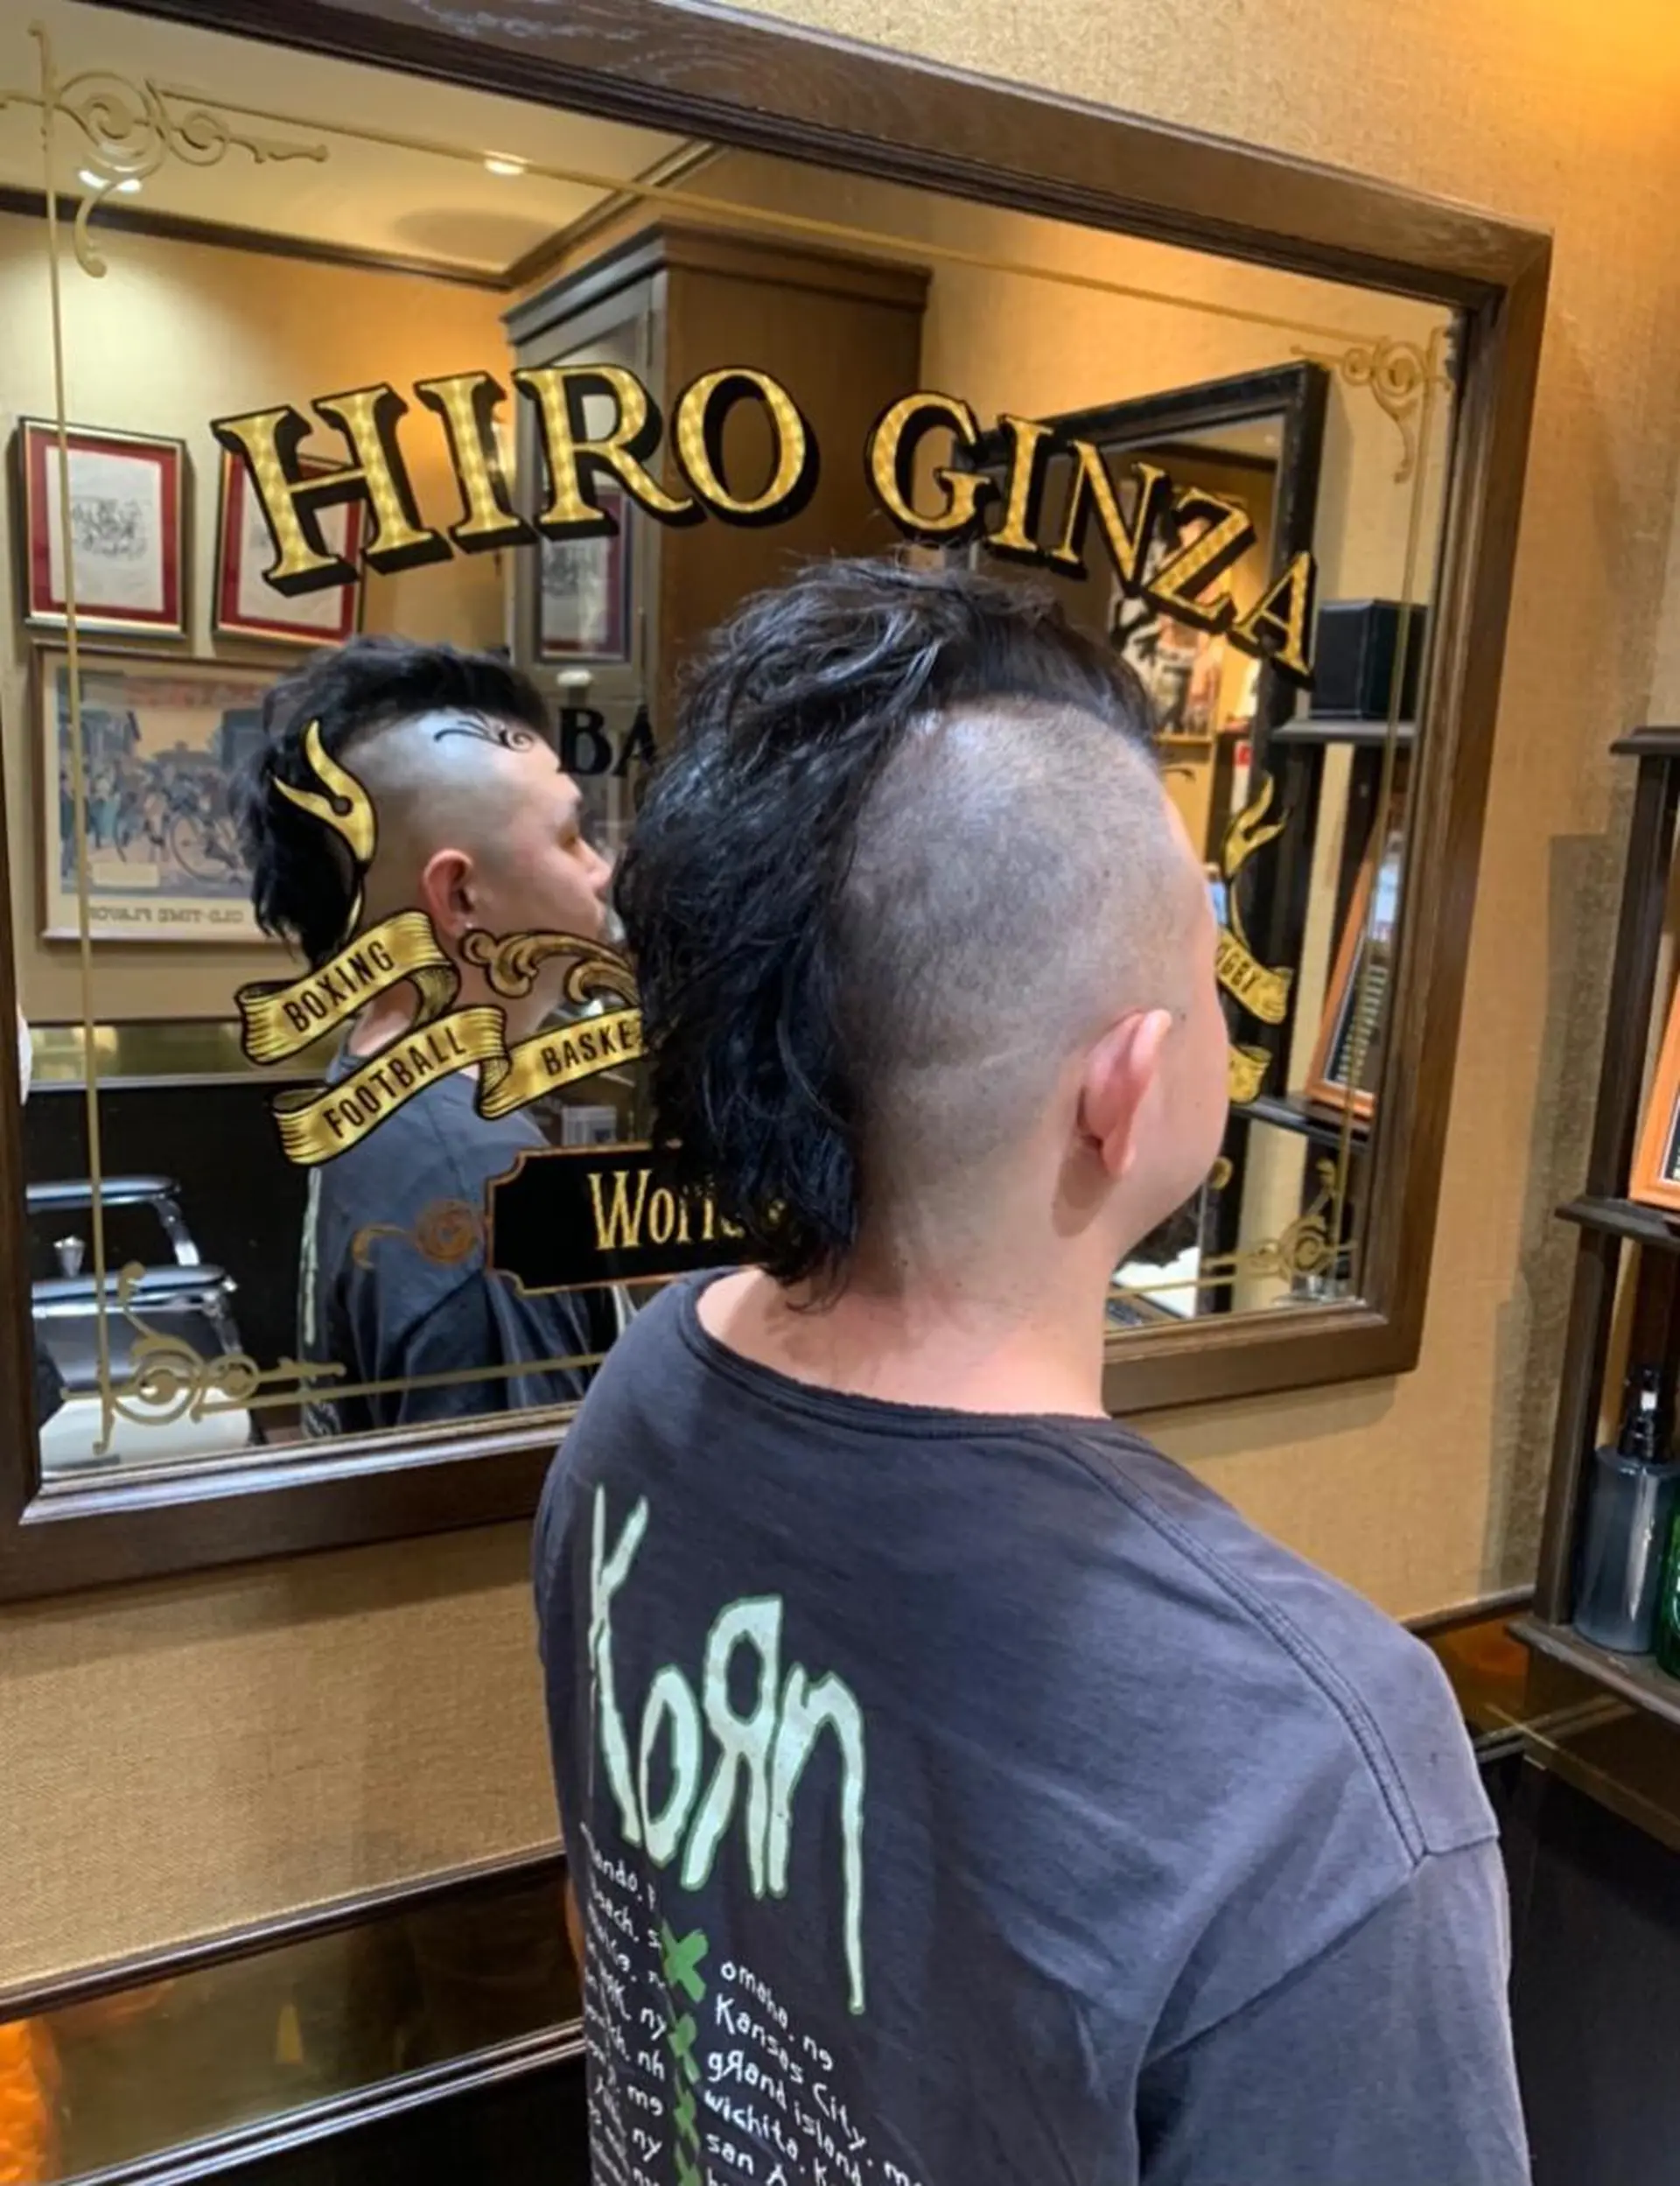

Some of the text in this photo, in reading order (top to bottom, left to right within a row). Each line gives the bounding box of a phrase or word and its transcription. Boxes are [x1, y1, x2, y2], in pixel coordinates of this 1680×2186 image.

[211, 362, 1318, 684] HIRO GINZA
[283, 940, 396, 1033] BOXING
[542, 1018, 644, 1077] BASKE
[323, 1026, 466, 1139] FOOTBALL
[640, 2007, 666, 2042] ny
[715, 1993, 804, 2084] Kansas
[638, 2049, 665, 2081] nh
[633, 2128, 662, 2162] ny
[706, 2133, 754, 2175] san
